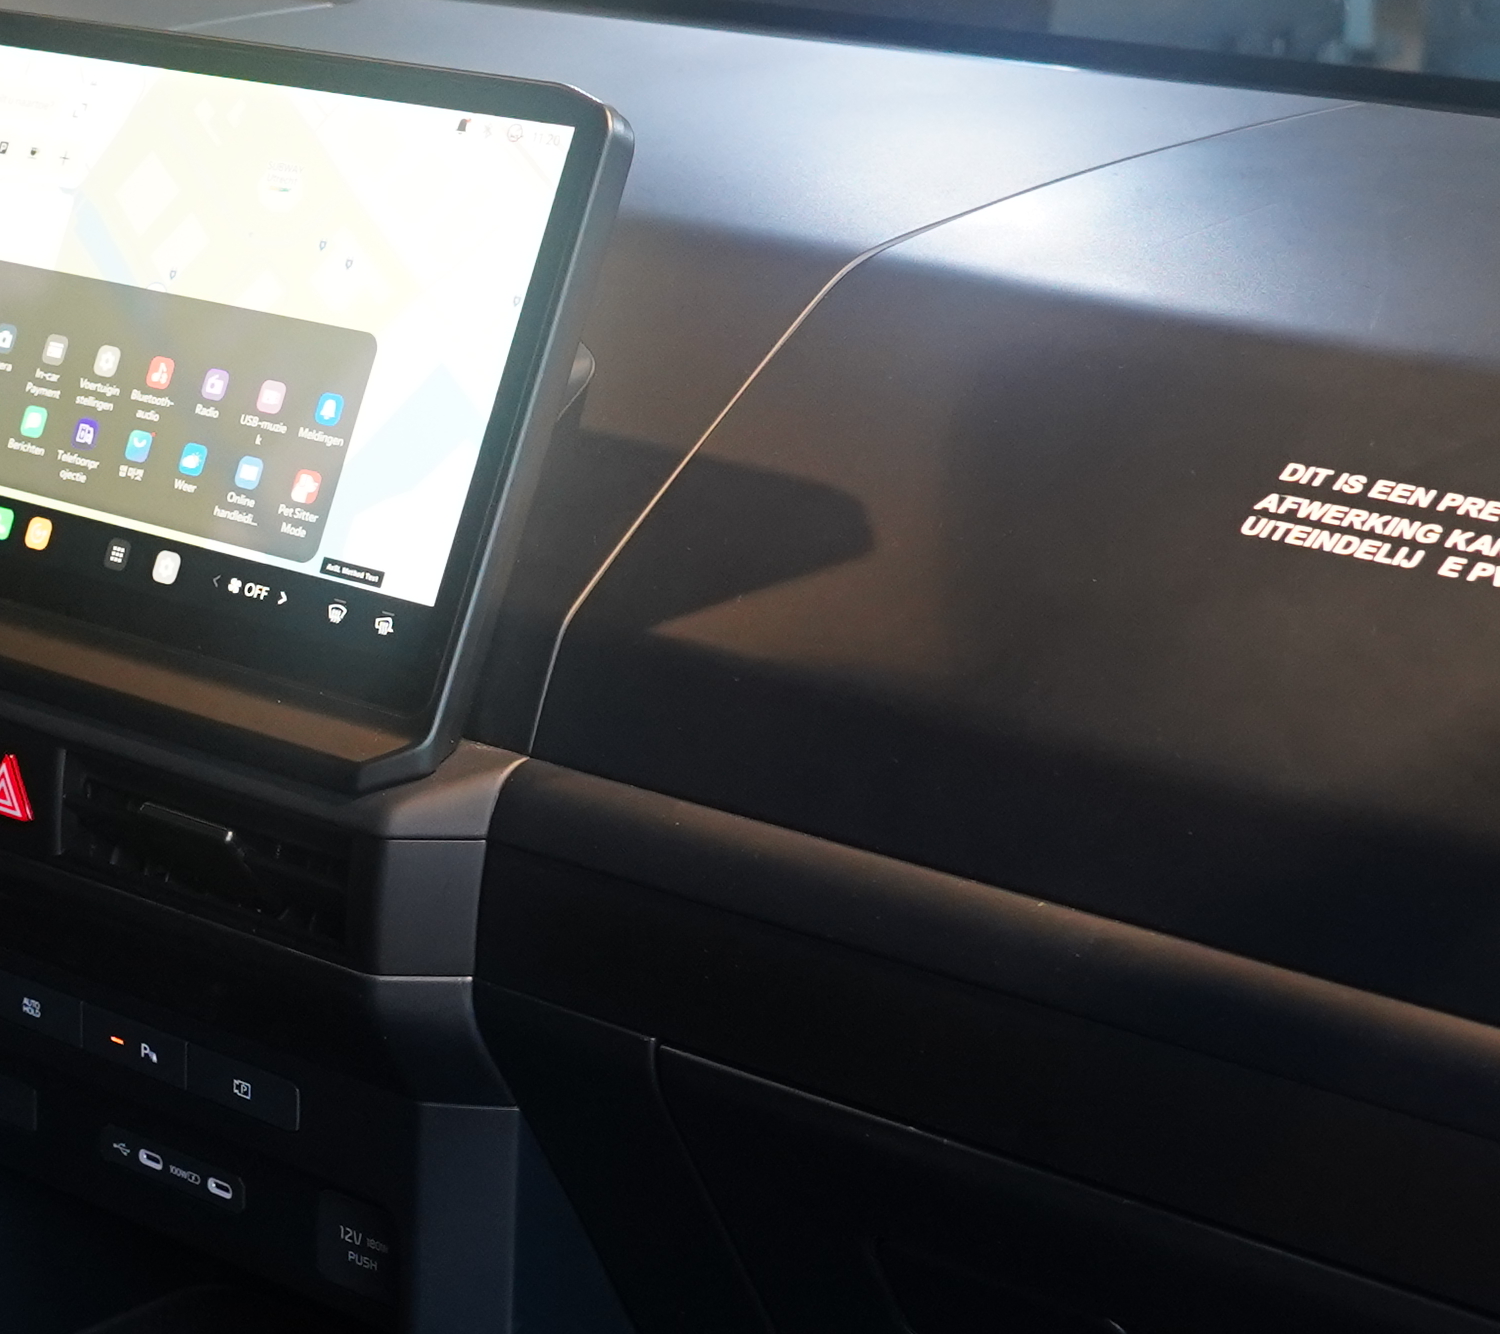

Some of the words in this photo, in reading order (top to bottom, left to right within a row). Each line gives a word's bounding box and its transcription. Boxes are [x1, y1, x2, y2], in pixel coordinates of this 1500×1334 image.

[35, 368, 60, 382] In-car
[26, 382, 61, 399] Payment
[80, 378, 120, 397] Voertuigin
[76, 394, 113, 411] stellingen
[130, 389, 174, 408] Bluetooth-
[136, 410, 160, 421] audio
[195, 404, 219, 419] Radio
[240, 414, 287, 434] USB-muzie
[255, 435, 262, 445] k
[298, 427, 344, 447] Meldingen
[8, 438, 45, 456] Berichten
[57, 450, 99, 470] Telefoonpr
[59, 469, 86, 484] ojectie
[174, 478, 197, 494] Weer
[1278, 462, 1334, 489] DIT
[1333, 470, 1367, 494] IS
[1367, 479, 1437, 509] EEN
[227, 492, 255, 508] Online
[278, 504, 295, 517] Pet
[296, 508, 319, 523] Sitter
[1254, 492, 1443, 545] AFWERKING
[281, 522, 307, 538] Mode
[244, 582, 270, 601] OFF
[22, 997, 41, 1009] AUTO
[22, 1005, 41, 1018] HOLD
[339, 1225, 362, 1246] 12V
[348, 1250, 378, 1271] PUSH
